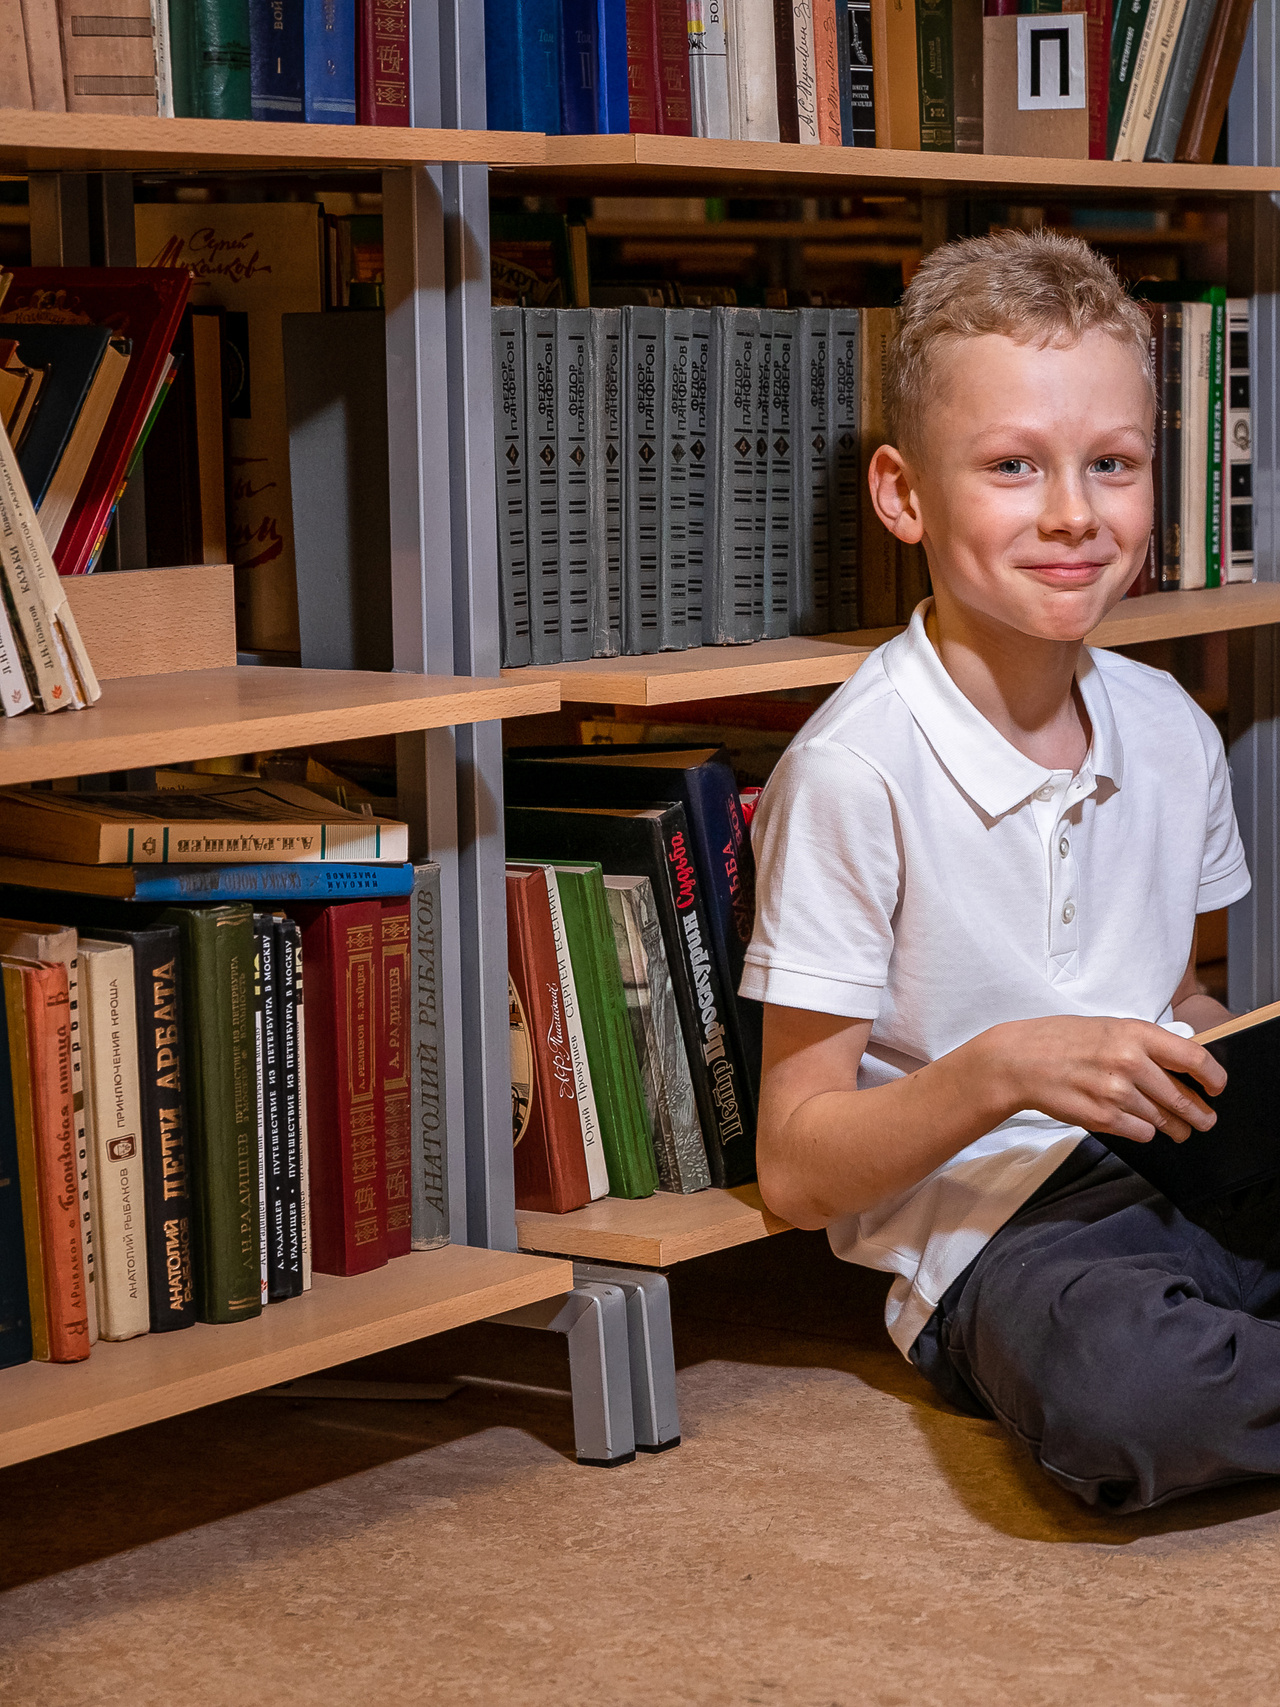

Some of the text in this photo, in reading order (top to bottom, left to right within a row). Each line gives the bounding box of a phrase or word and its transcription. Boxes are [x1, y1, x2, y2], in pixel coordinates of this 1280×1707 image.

[1030, 28, 1070, 97] П
[501, 361, 510, 414] ФЕДОР
[506, 341, 518, 431] ПАНФЕРОВ
[537, 362, 546, 415] ФЕДОР
[545, 343, 554, 432] ПАНФЕРОВ
[568, 364, 578, 417] ФЕДОР
[577, 345, 585, 432] ПАНФЕРОВ
[609, 344, 618, 432] ПАНФЕРОВ
[637, 363, 645, 414] ФЕДОР
[644, 343, 656, 431] ПАНФЕРОВ
[671, 363, 679, 414] ФЕДОР
[677, 345, 688, 431] ПАНФЕРОВ
[690, 361, 700, 411] ФЕДОР
[698, 343, 709, 428] ПАНФЕРОВ
[734, 359, 743, 409] ФЕДОР
[742, 340, 753, 425] ПАНФЕРОВ
[761, 342, 772, 426] ПАНФЕРОВ
[772, 360, 782, 410] ФЕДОР
[781, 342, 791, 426] ПАНФЕРОВ
[817, 340, 826, 422] ПАНФЕРОВ
[837, 358, 845, 406] ФЕДОР
[845, 340, 855, 421] ПАНФЕРОВ
[1212, 470, 1221, 554] ВАЛЕНТИН
[9, 545, 31, 594] КАЗАКИ
[177, 834, 313, 853] А.Н.РАДИЩЕВ
[326, 871, 377, 881] РЫЛЕНКОВ
[669, 831, 696, 909] Судьба
[327, 880, 378, 894] НИКОЛАЙ
[262, 935, 272, 981] МОСКВУ
[285, 940, 293, 982] МОСКВУ
[355, 964, 365, 1008] ЗАЙЦЕВ
[683, 910, 726, 1066] Проскурин
[286, 989, 293, 997] В
[388, 966, 402, 1048] РАДИЩЕВ
[57, 1025, 71, 1095] птица
[265, 996, 275, 1064] ПЕТЕРБУРГА
[286, 1001, 294, 1068] ПЕТЕРБУРГА
[357, 1024, 366, 1077] РЕМИЗОВ
[416, 889, 444, 1217] АНАТОЛИЙ РЫБАКОВ
[152, 957, 189, 1201] ДЕТИ АРБАТА
[268, 1069, 276, 1085] ИЗ
[286, 1073, 295, 1088] ИЗ
[571, 1034, 588, 1101] Прокушев
[56, 1103, 77, 1211] Бронзовая
[109, 978, 138, 1299] АНАТОЛИЙ РЫБАКОВ ПРИКЛЮЧЕНИЯ КРОША
[269, 1090, 281, 1175] ПУТЕШЕСТВИЕ
[287, 1094, 296, 1178] ПУТЕШЕСТВИЕ
[582, 1106, 595, 1147] Юрий
[274, 1199, 284, 1255] РАДИЩЕВ
[289, 1202, 299, 1258] РАДИЩЕВ
[164, 1218, 184, 1311] АНАТОЛИЙ
